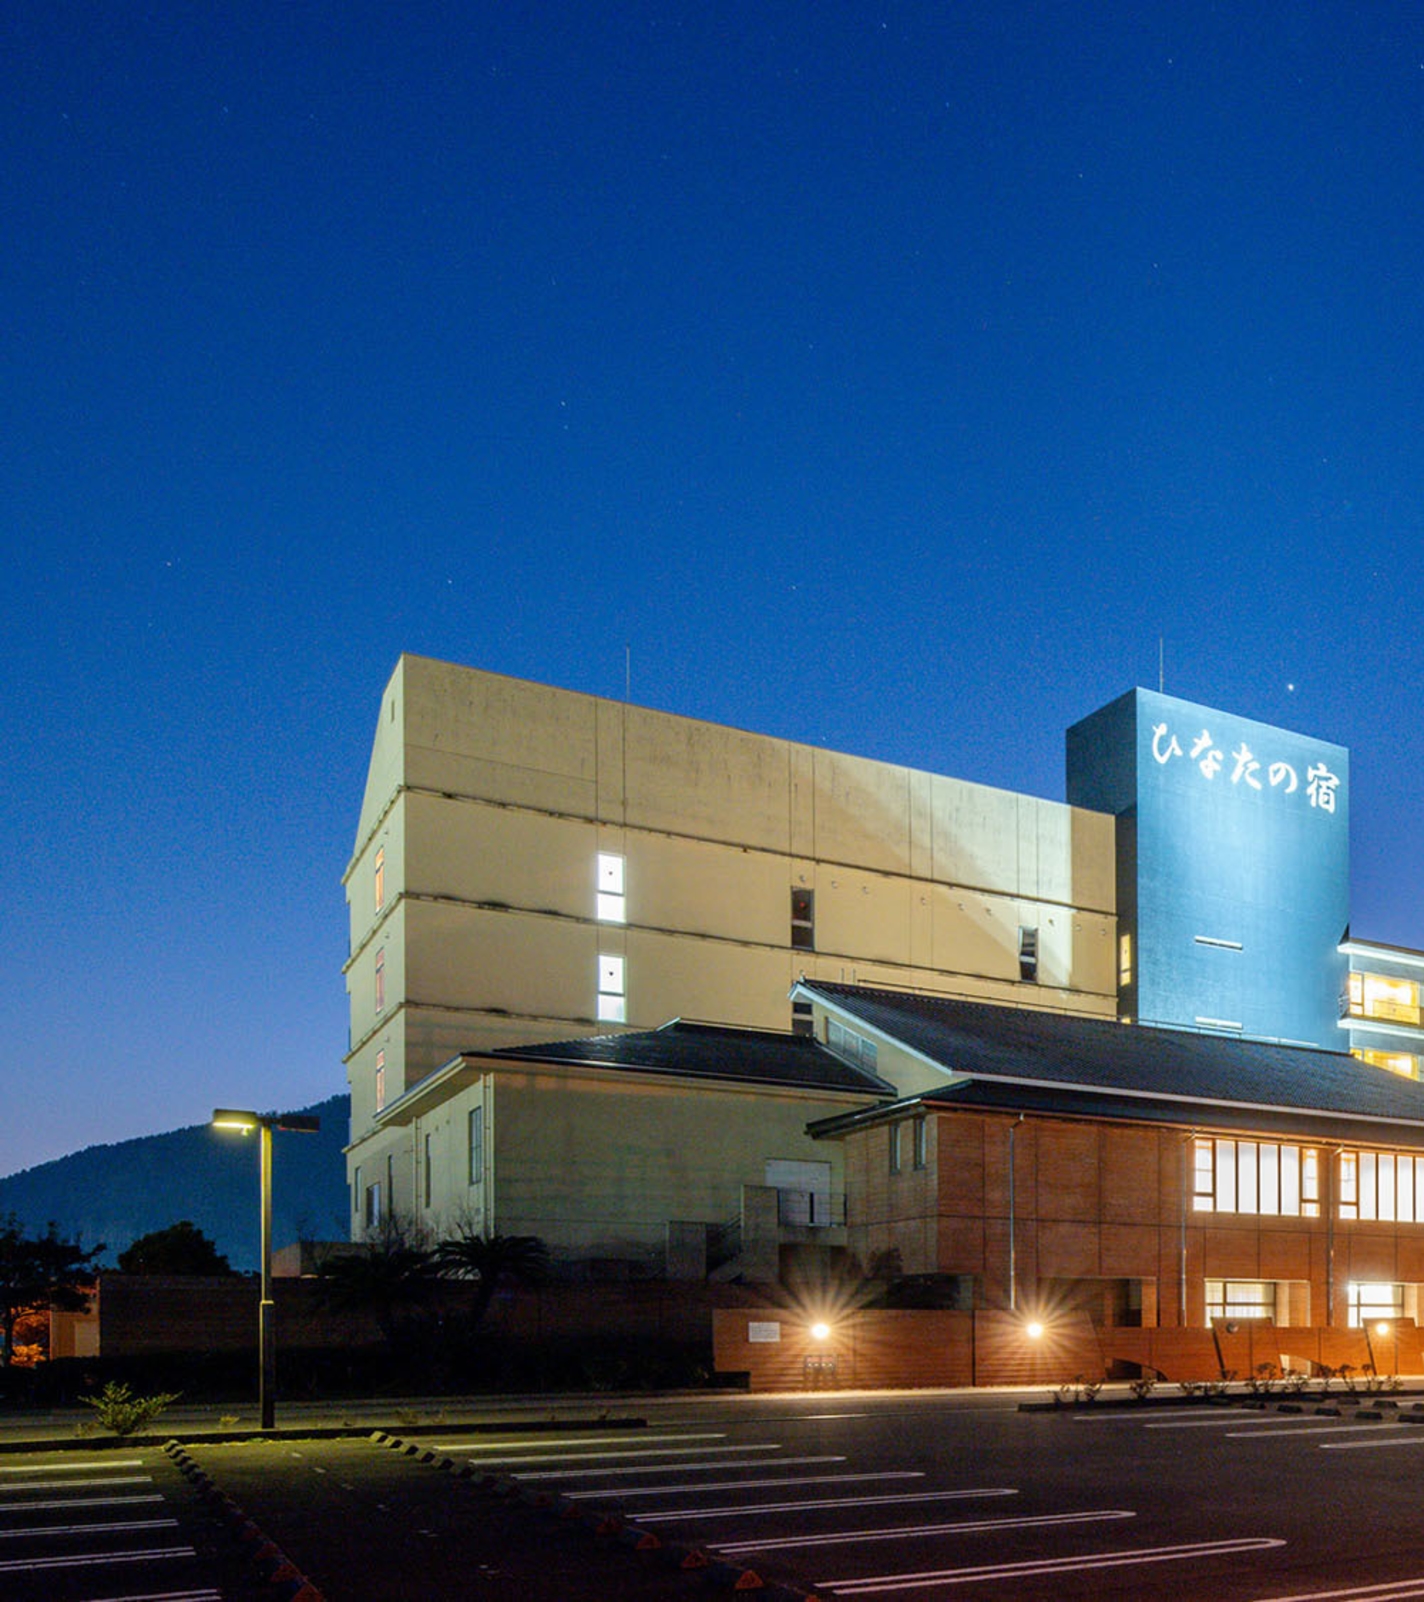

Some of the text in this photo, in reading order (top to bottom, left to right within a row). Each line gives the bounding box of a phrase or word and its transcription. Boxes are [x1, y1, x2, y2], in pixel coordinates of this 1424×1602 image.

[1152, 723, 1340, 813] ひなたの宿
